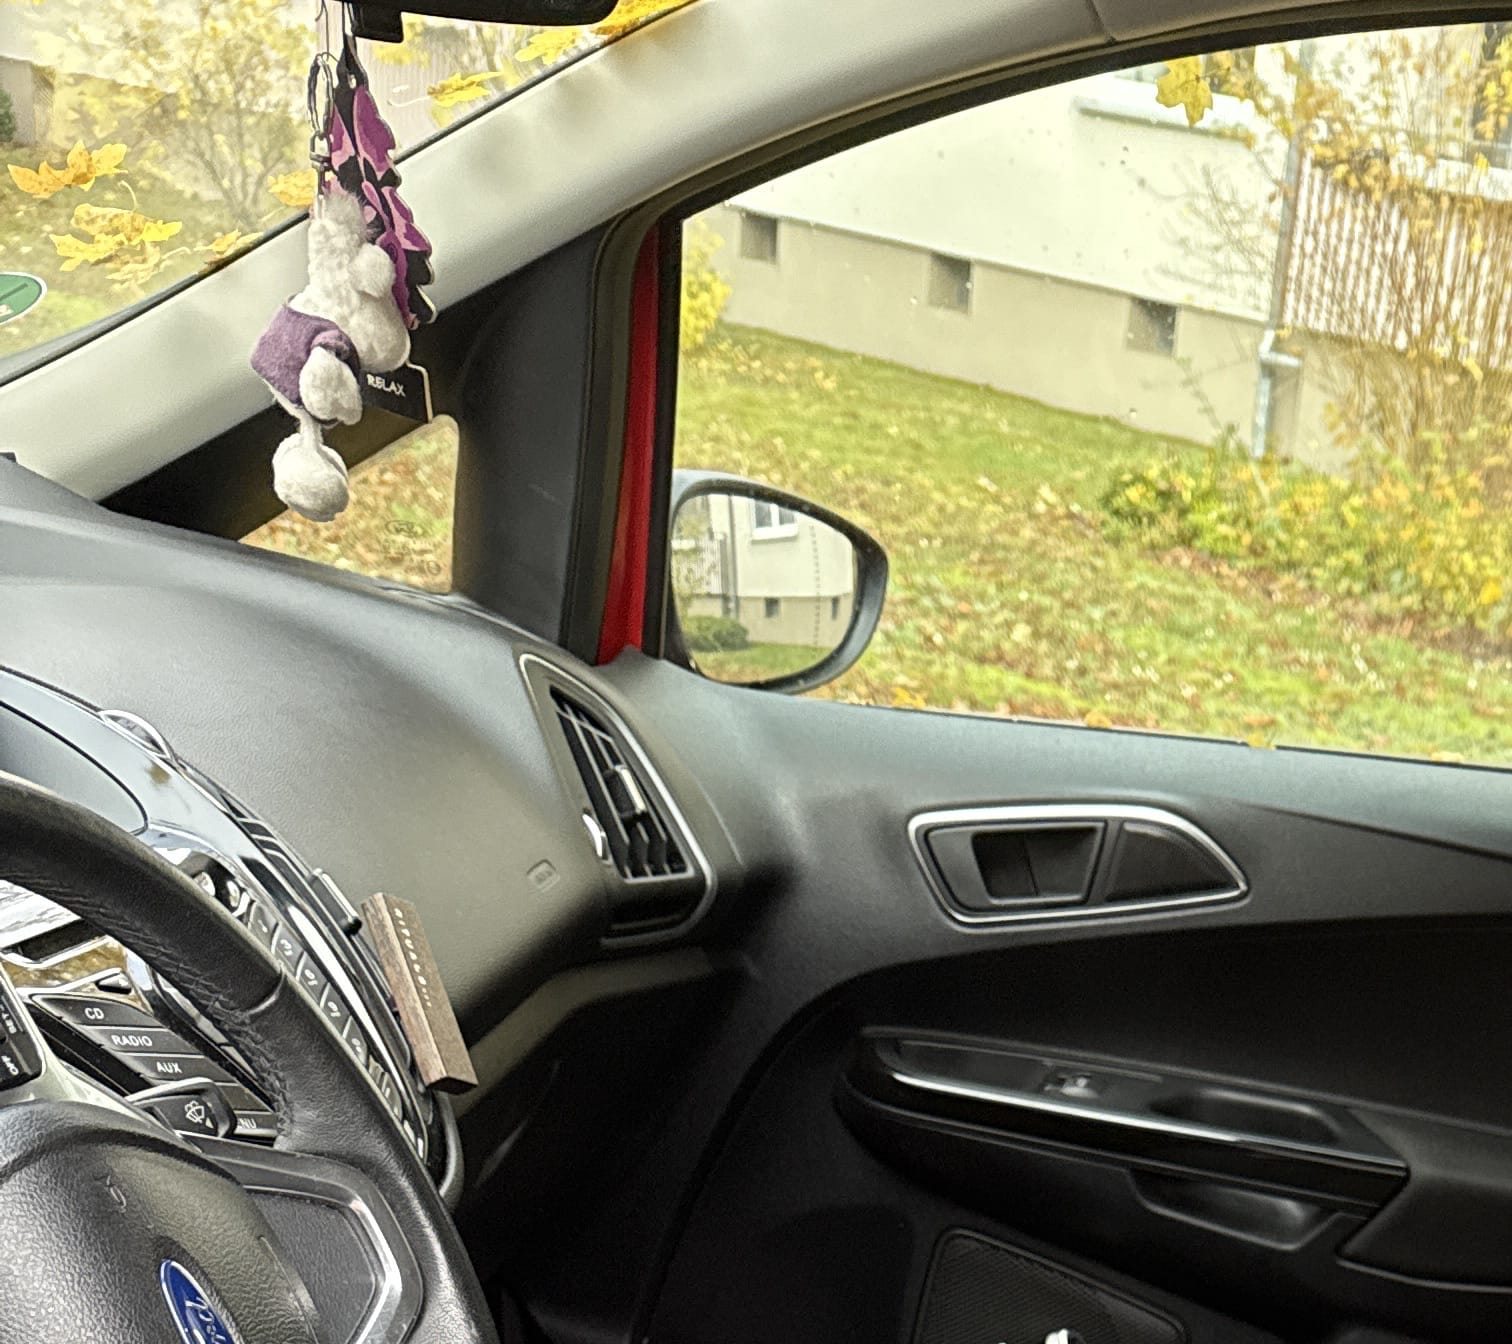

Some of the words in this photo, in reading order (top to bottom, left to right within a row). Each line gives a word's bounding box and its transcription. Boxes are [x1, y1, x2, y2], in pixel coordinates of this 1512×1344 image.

[366, 373, 406, 397] RELAX
[84, 1007, 105, 1020] CD
[111, 1034, 153, 1047] RADIO
[156, 1062, 182, 1074] AUX
[237, 1117, 257, 1129] NU
